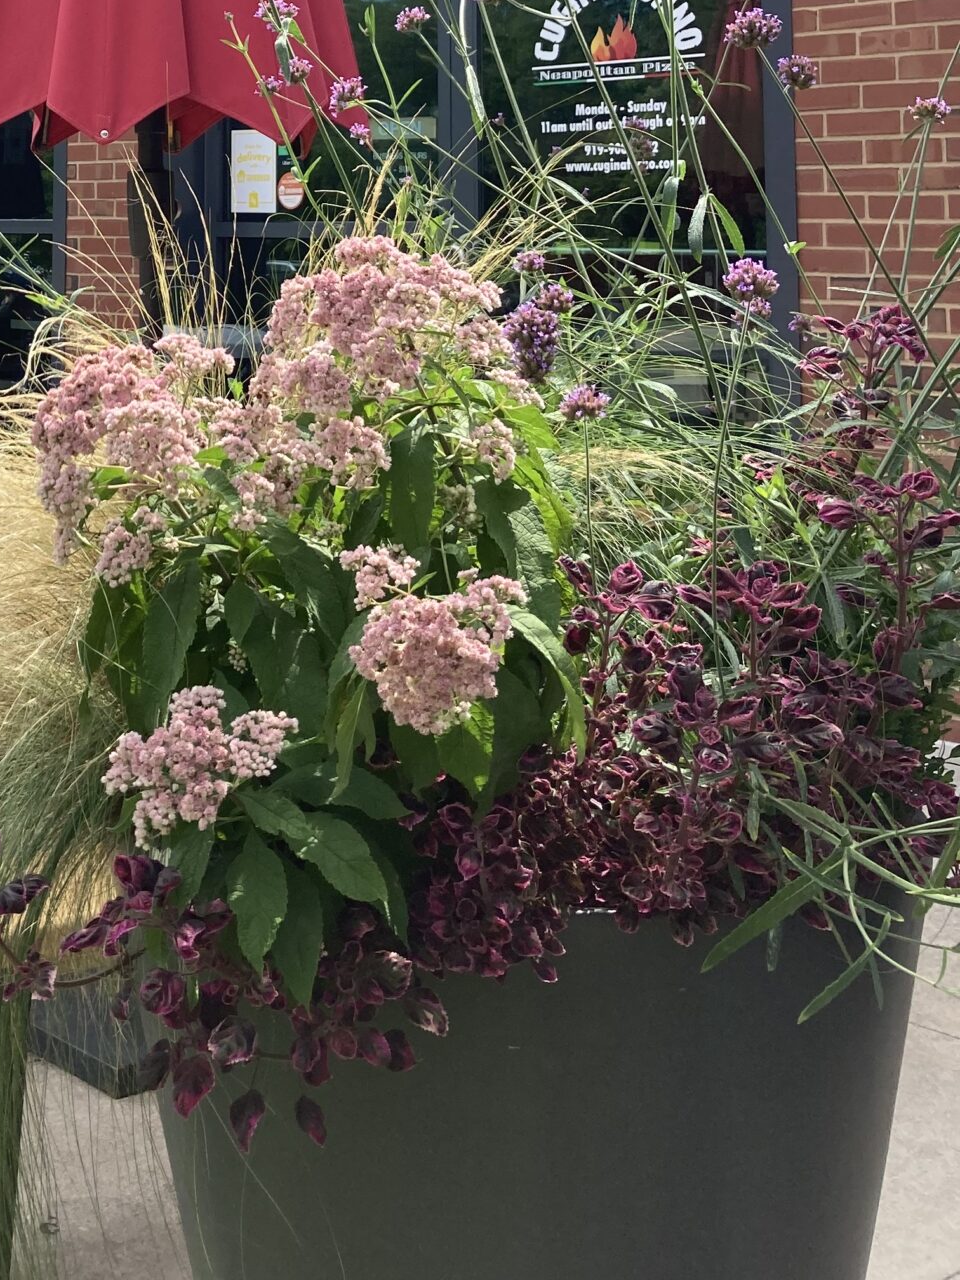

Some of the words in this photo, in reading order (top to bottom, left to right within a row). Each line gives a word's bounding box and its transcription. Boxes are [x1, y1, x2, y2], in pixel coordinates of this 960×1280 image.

[539, 65, 636, 81] Neapoitan
[627, 98, 667, 114] Sunday
[541, 121, 567, 134] 11am
[569, 117, 593, 132] until
